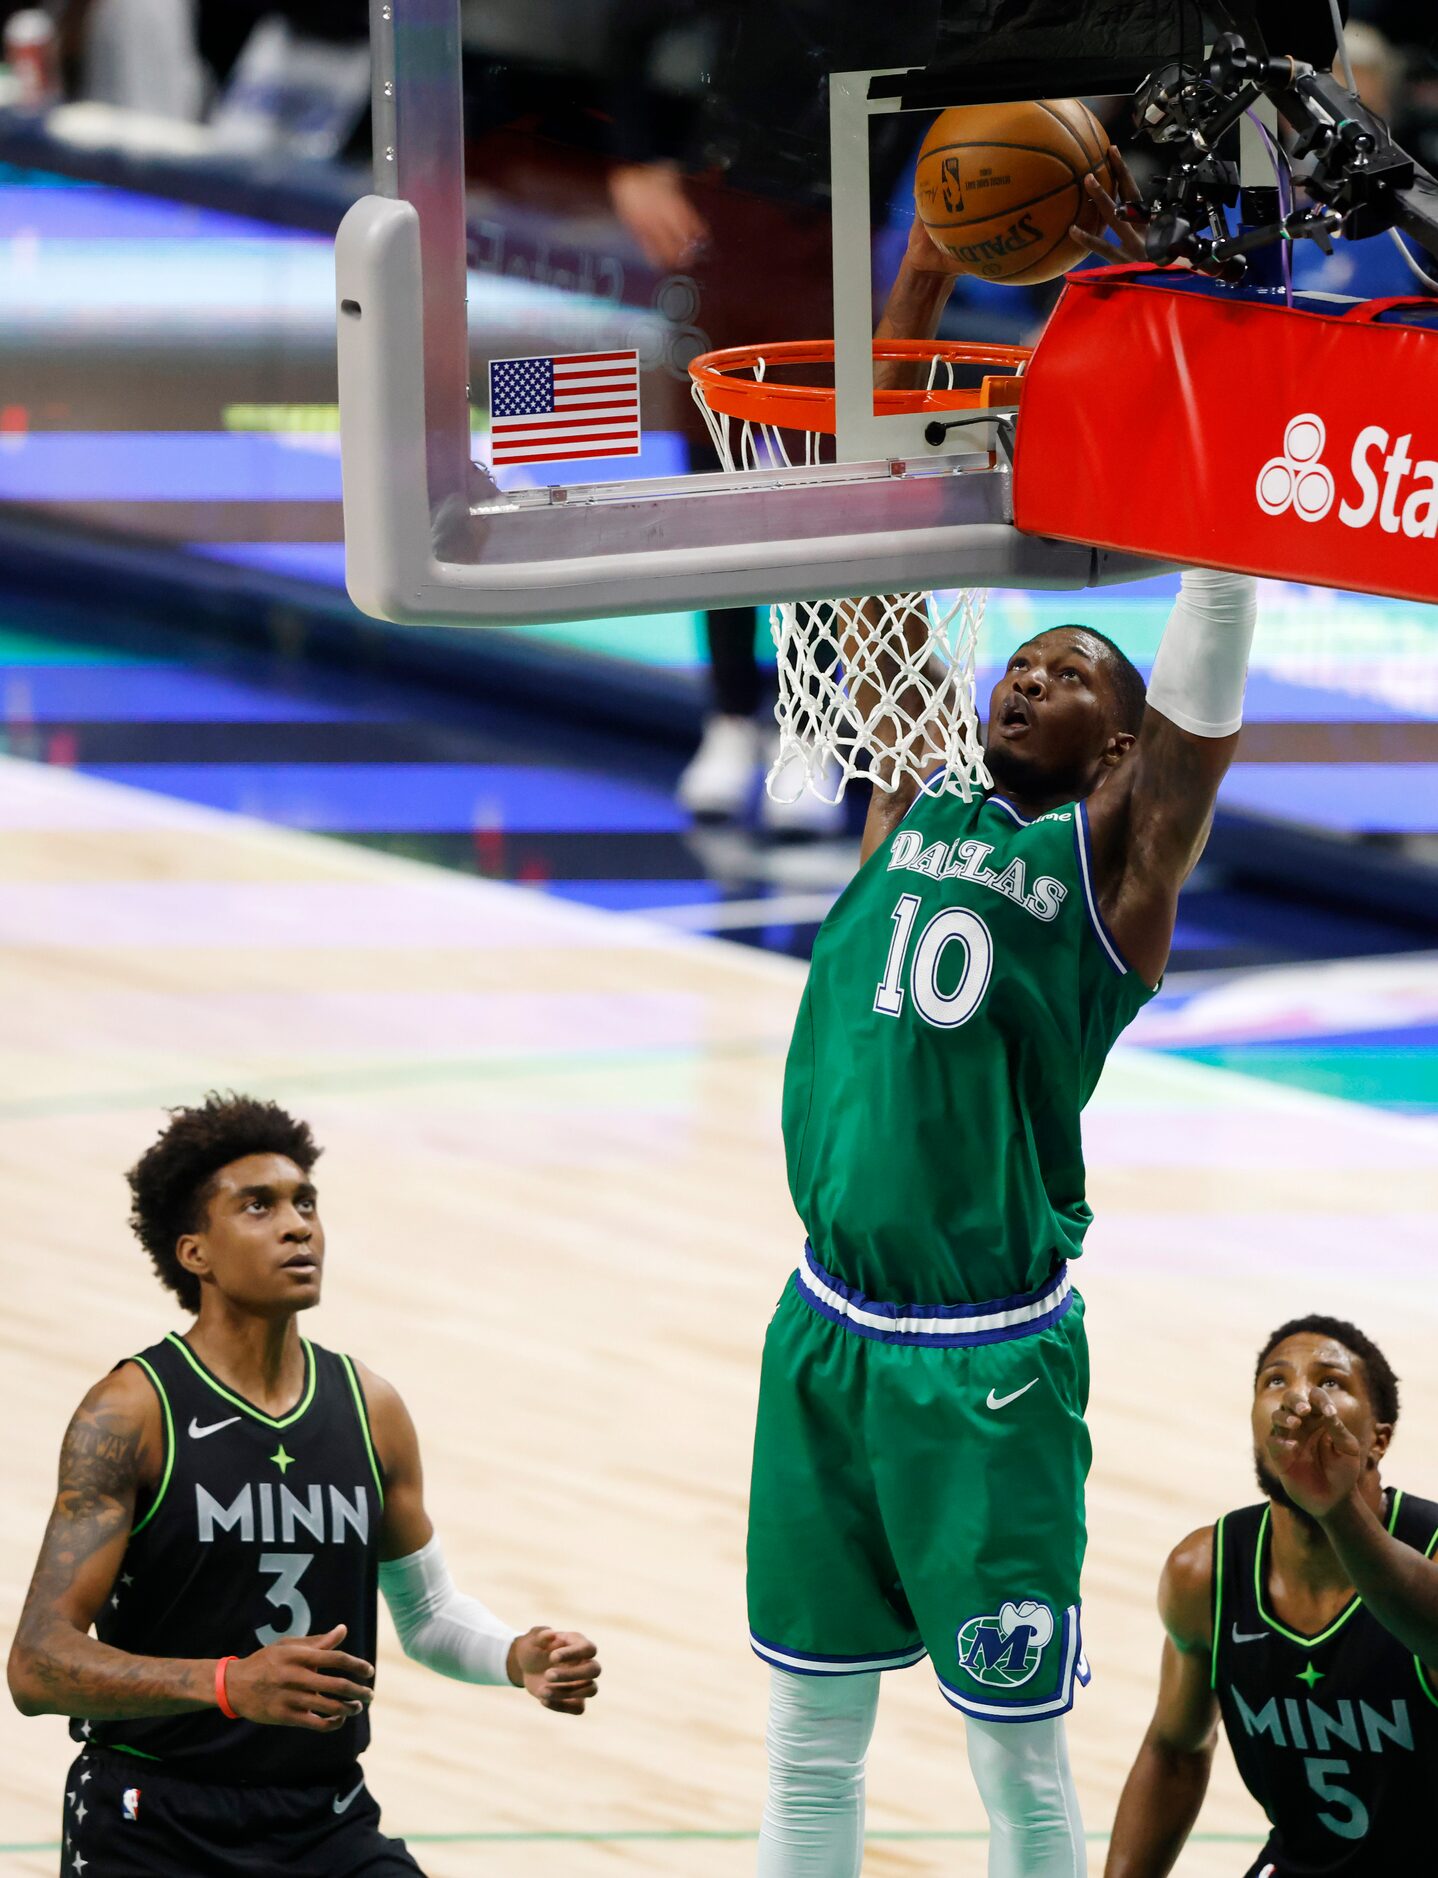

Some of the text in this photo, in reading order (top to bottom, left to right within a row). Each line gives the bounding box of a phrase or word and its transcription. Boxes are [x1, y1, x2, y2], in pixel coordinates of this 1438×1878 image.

[1338, 425, 1438, 539] Sta
[887, 830, 1069, 922] DALLAS
[872, 892, 994, 1029] 10
[195, 1482, 370, 1546] MINN
[254, 1552, 315, 1648] 3
[959, 1624, 1040, 1672] M
[1230, 1683, 1415, 1753] MINN
[1303, 1756, 1370, 1840] 5
